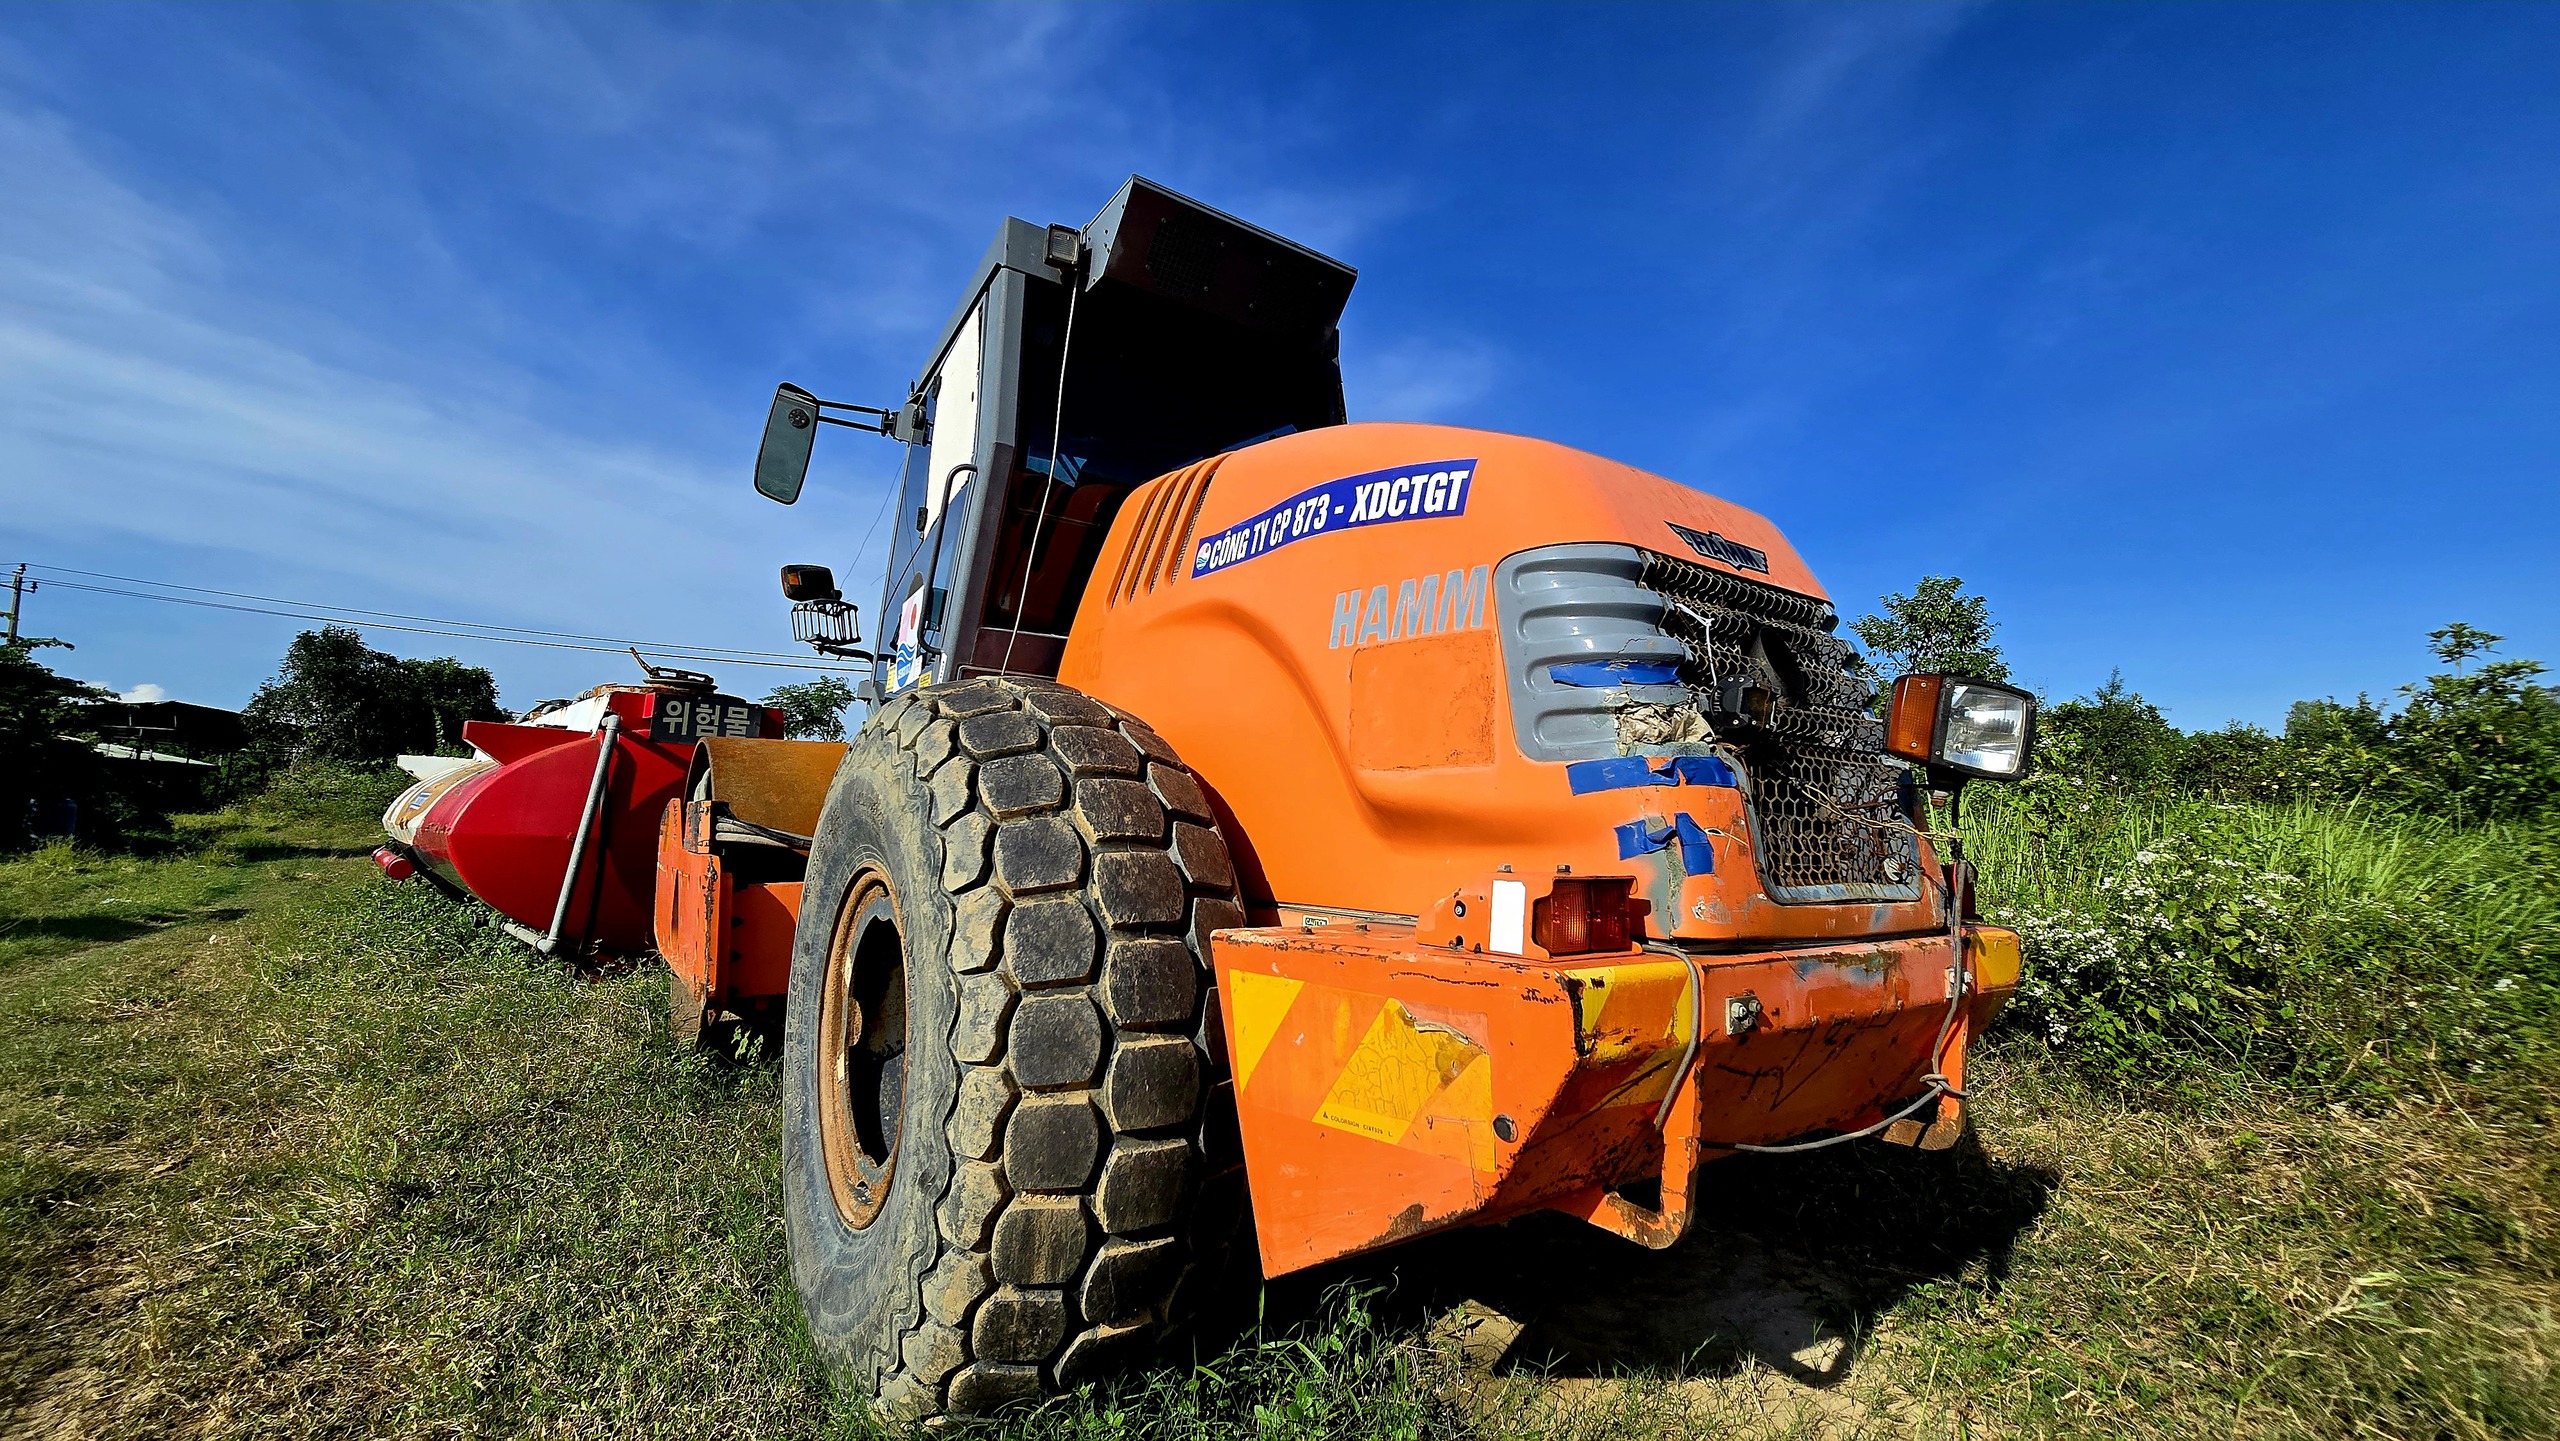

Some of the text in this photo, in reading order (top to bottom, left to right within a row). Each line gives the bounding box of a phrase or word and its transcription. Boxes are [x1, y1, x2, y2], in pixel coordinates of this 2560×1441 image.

[1209, 530, 1251, 570] CÔNG
[1250, 517, 1271, 555] TY
[1269, 508, 1292, 547] CP
[1292, 493, 1330, 537] 873
[1348, 470, 1470, 523] XDCTGT
[1329, 564, 1490, 650] HAMM
[663, 700, 750, 738] 위험물
